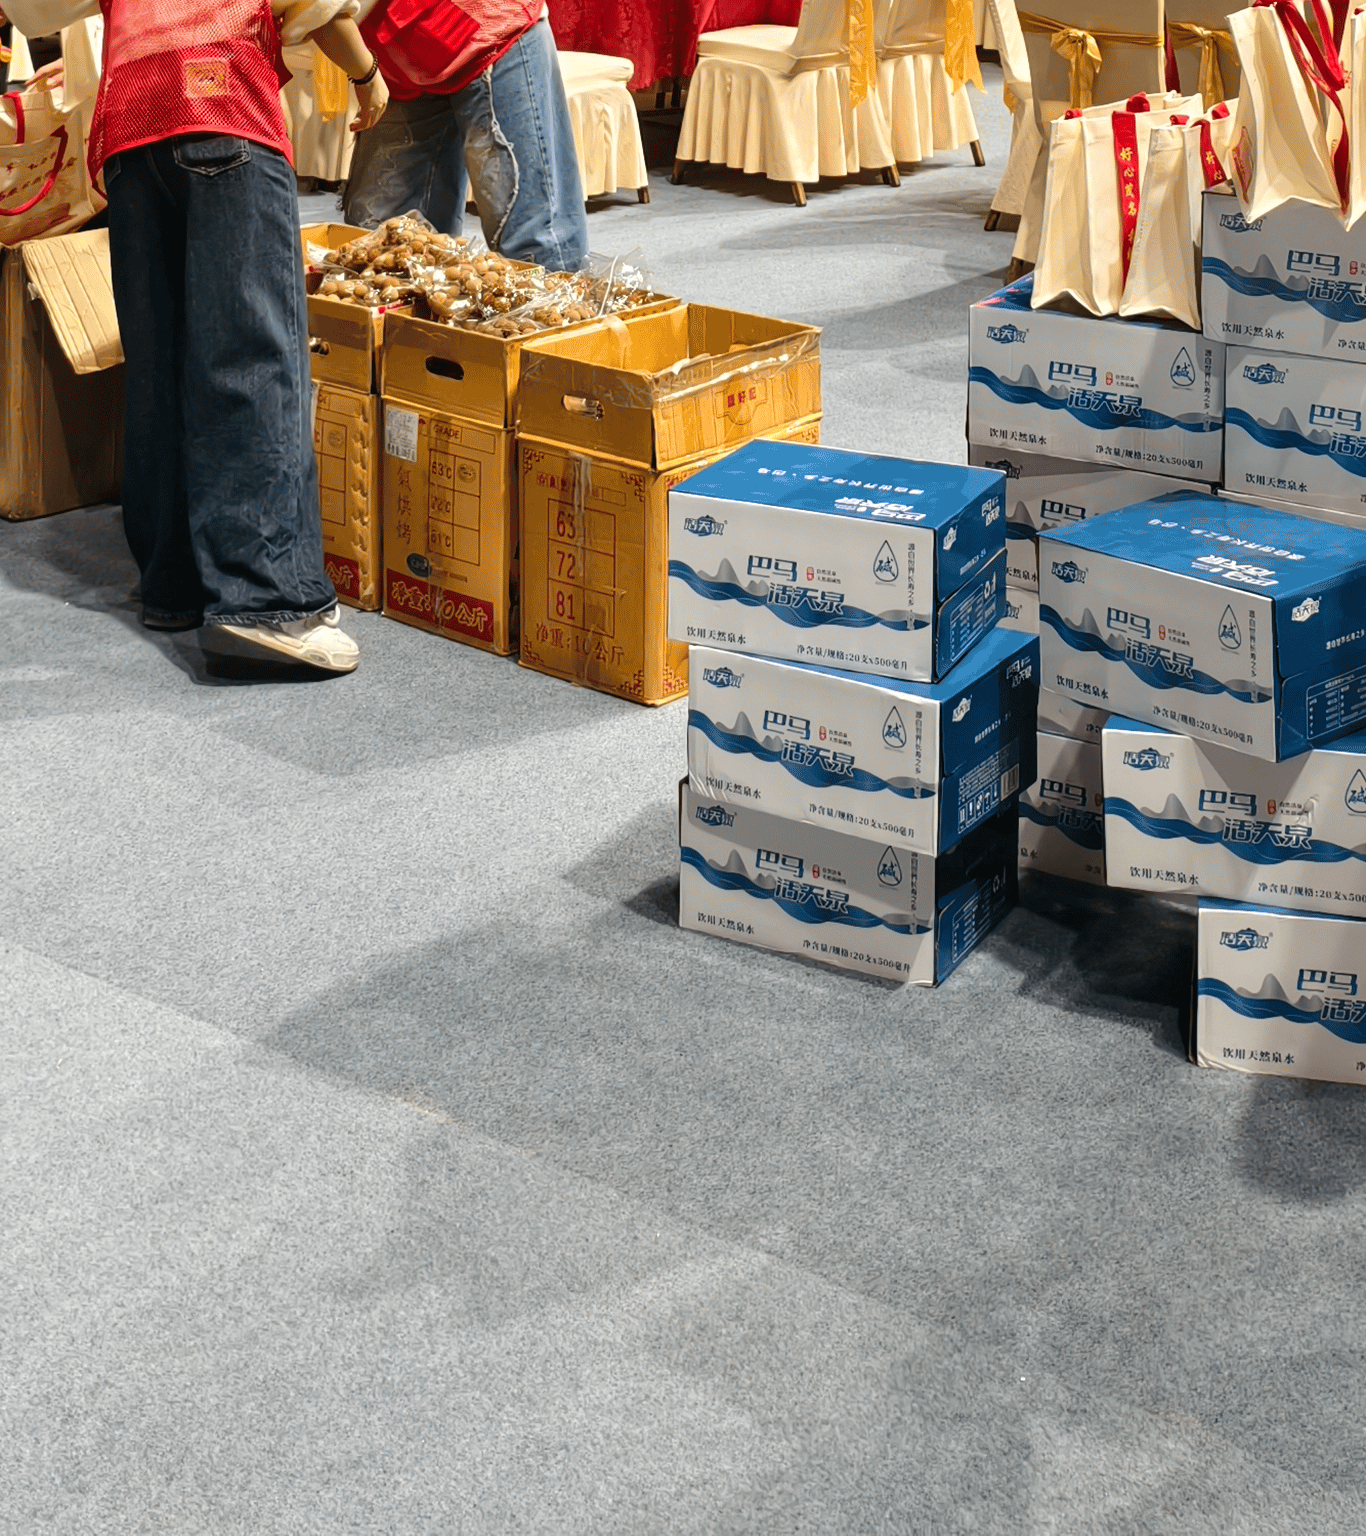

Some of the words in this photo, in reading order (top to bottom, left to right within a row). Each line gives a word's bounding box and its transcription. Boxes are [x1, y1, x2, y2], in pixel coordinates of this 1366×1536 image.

[1286, 250, 1340, 276] 巴马
[1221, 322, 1285, 340] 饮用天然泉水
[1048, 360, 1097, 387] 巴马
[1067, 387, 1143, 418] 活天泉
[1309, 404, 1362, 431] 巴马
[989, 427, 1047, 445] 饮用天然泉水
[1245, 472, 1308, 493] 饮用天然泉水
[556, 510, 576, 539] 63
[556, 550, 576, 580] 72
[747, 555, 797, 582] 巴马
[555, 591, 576, 620] 81
[767, 582, 845, 615] 活天泉
[686, 626, 747, 645] 饮用天然泉水
[1106, 606, 1152, 640] 巴马
[1124, 637, 1194, 679] 活天泉
[1055, 674, 1109, 700] 饮用天然泉水
[763, 710, 810, 740] 巴马
[780, 740, 855, 776] 活天泉
[705, 775, 762, 800] 饮用天然泉水
[1199, 789, 1257, 816] 巴马
[1223, 818, 1313, 850] 活天泉
[756, 848, 804, 878] 巴马
[1129, 866, 1199, 885] 饮用天然泉水
[774, 877, 850, 914] 活天泉
[697, 912, 755, 936] 饮用天然泉水
[1296, 968, 1358, 996] 巴马
[1223, 1047, 1295, 1065] 饮用天然泉水
